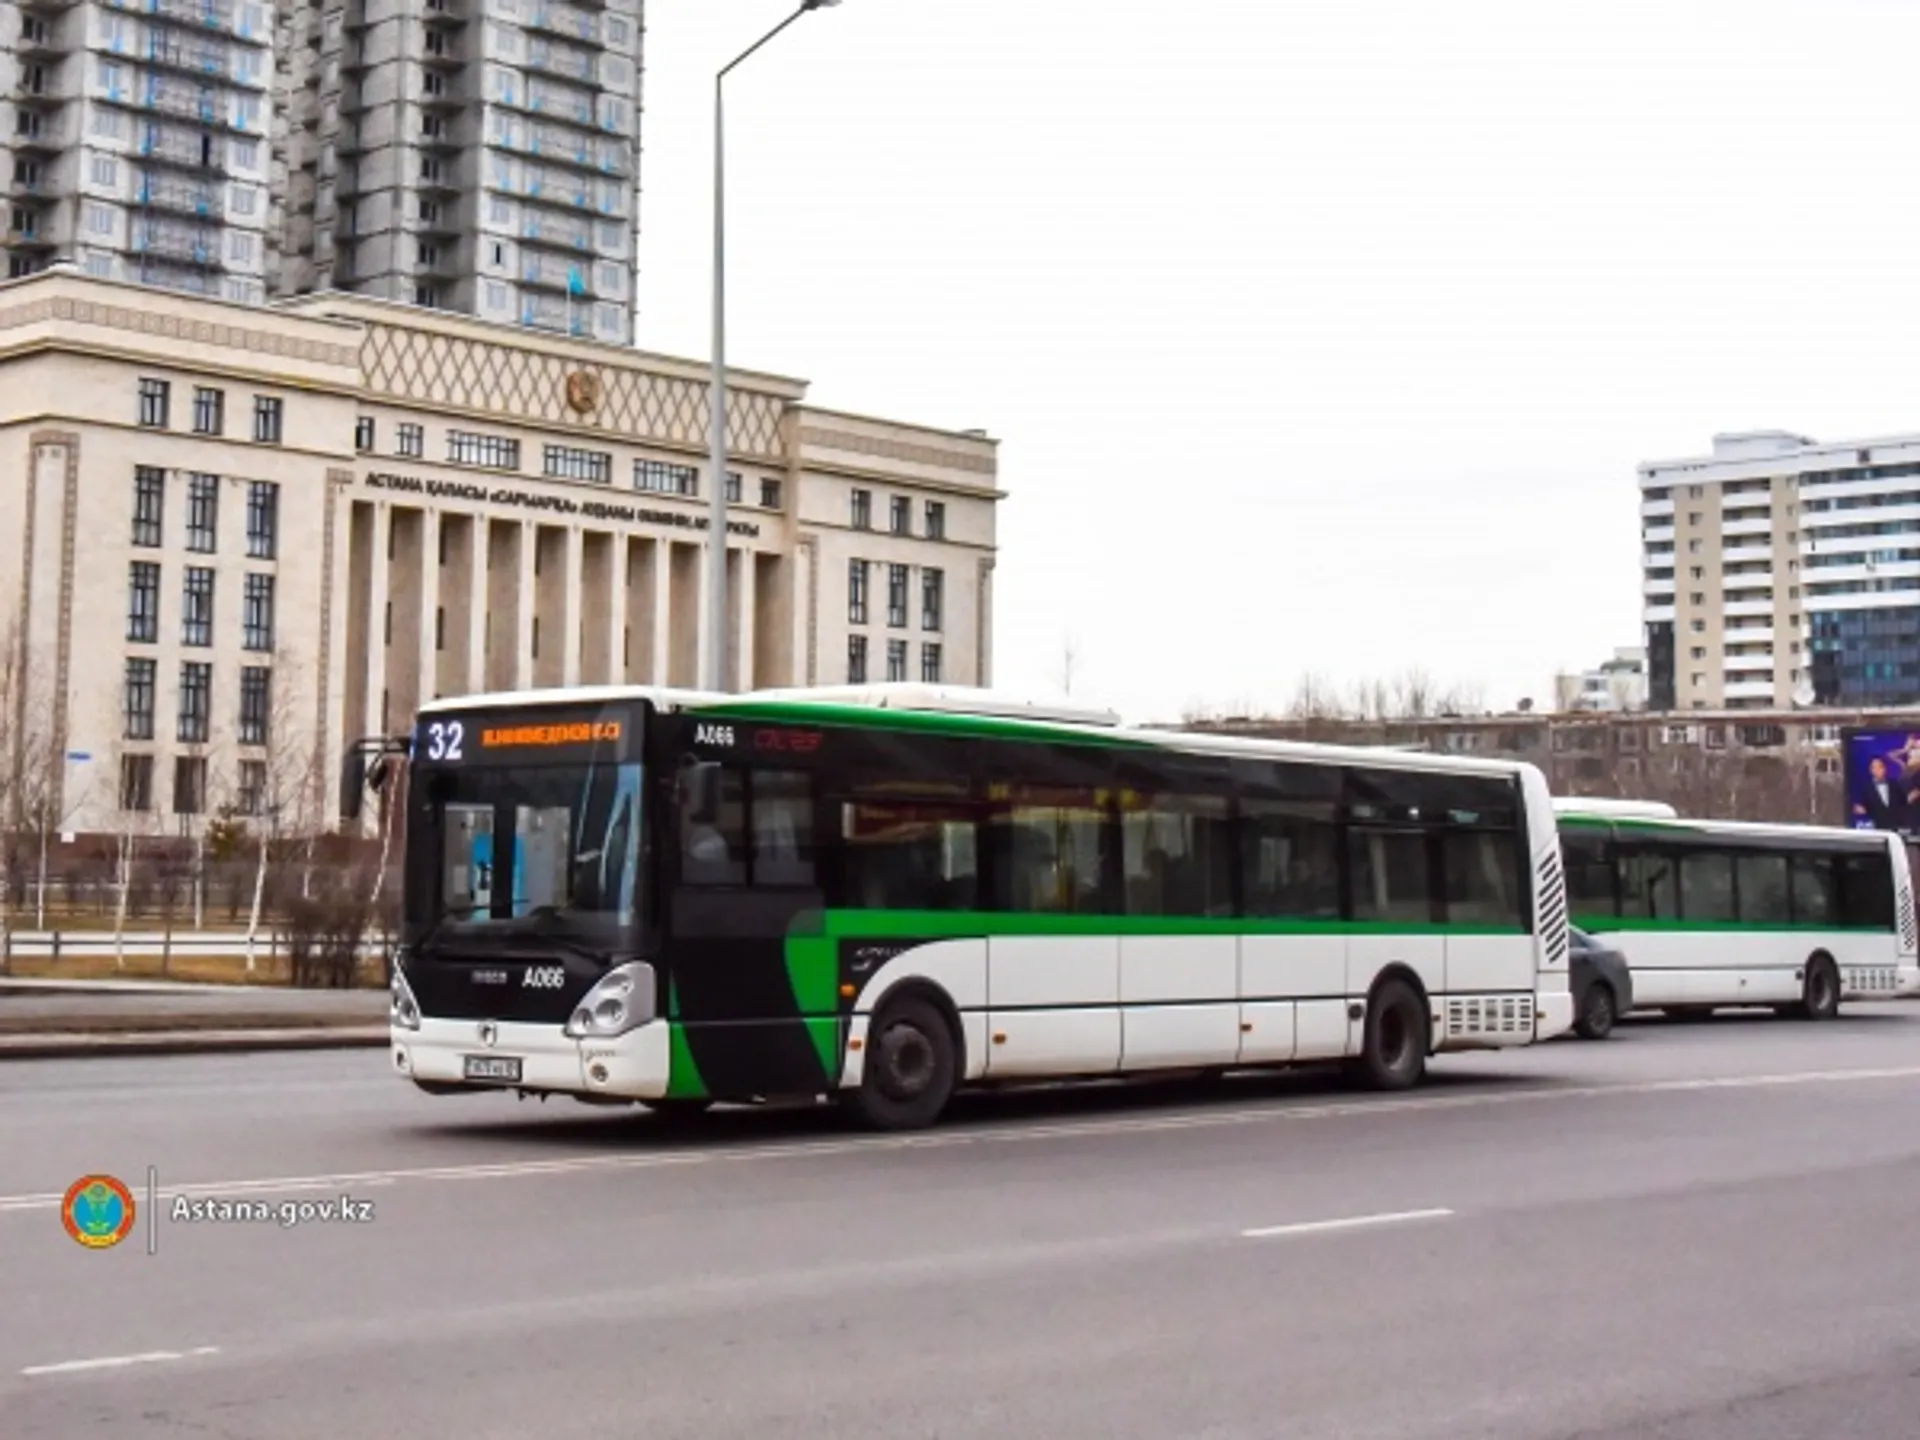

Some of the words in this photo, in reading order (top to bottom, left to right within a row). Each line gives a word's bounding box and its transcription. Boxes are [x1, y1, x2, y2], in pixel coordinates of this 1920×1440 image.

[365, 471, 423, 494] АСТАНА
[425, 479, 487, 501] ҚАЛАСЫ
[428, 720, 463, 760] 32
[522, 966, 565, 989] A066
